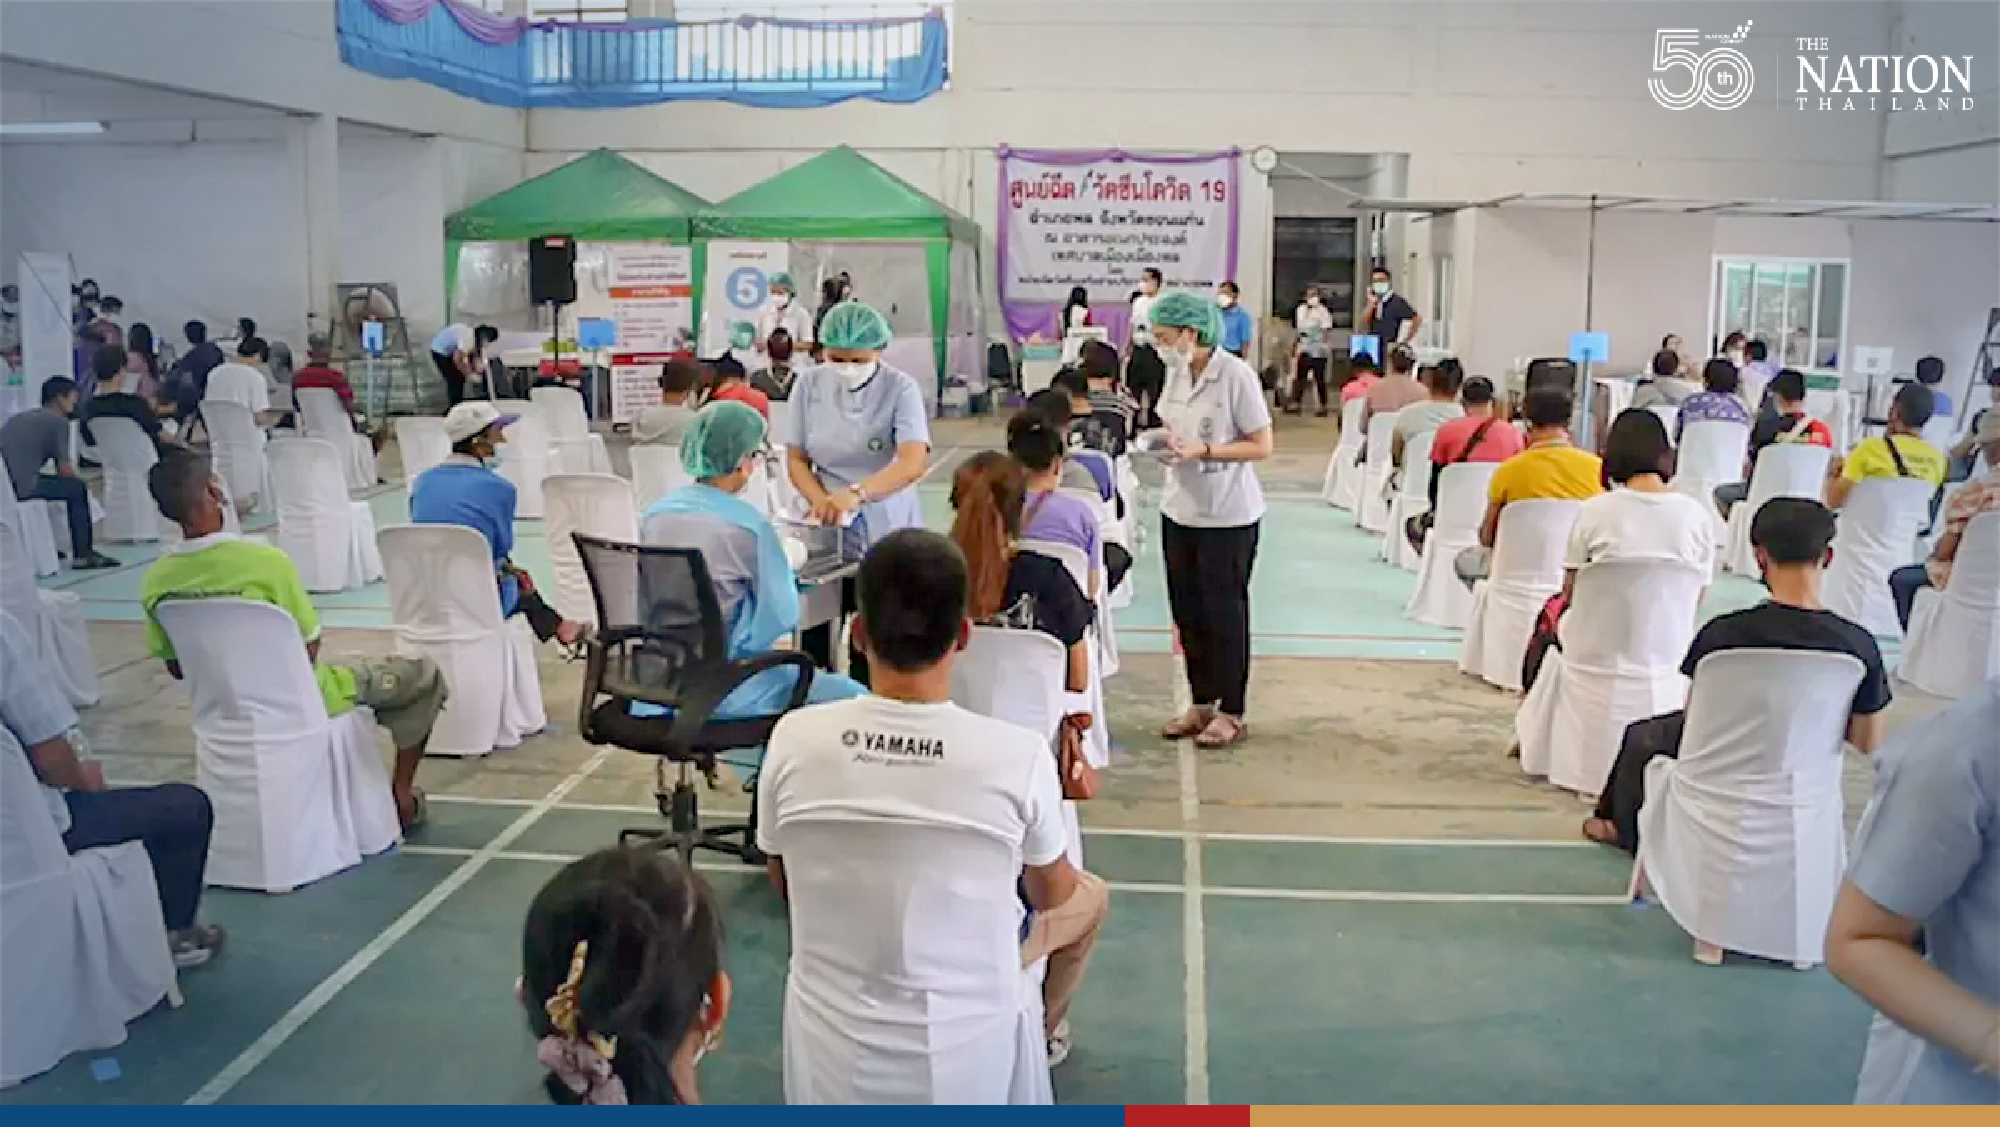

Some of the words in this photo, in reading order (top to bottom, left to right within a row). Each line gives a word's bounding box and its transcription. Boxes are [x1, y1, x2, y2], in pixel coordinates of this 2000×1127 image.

[1200, 180, 1226, 202] 19
[737, 273, 758, 303] 5
[864, 730, 944, 759] YAMAHA
